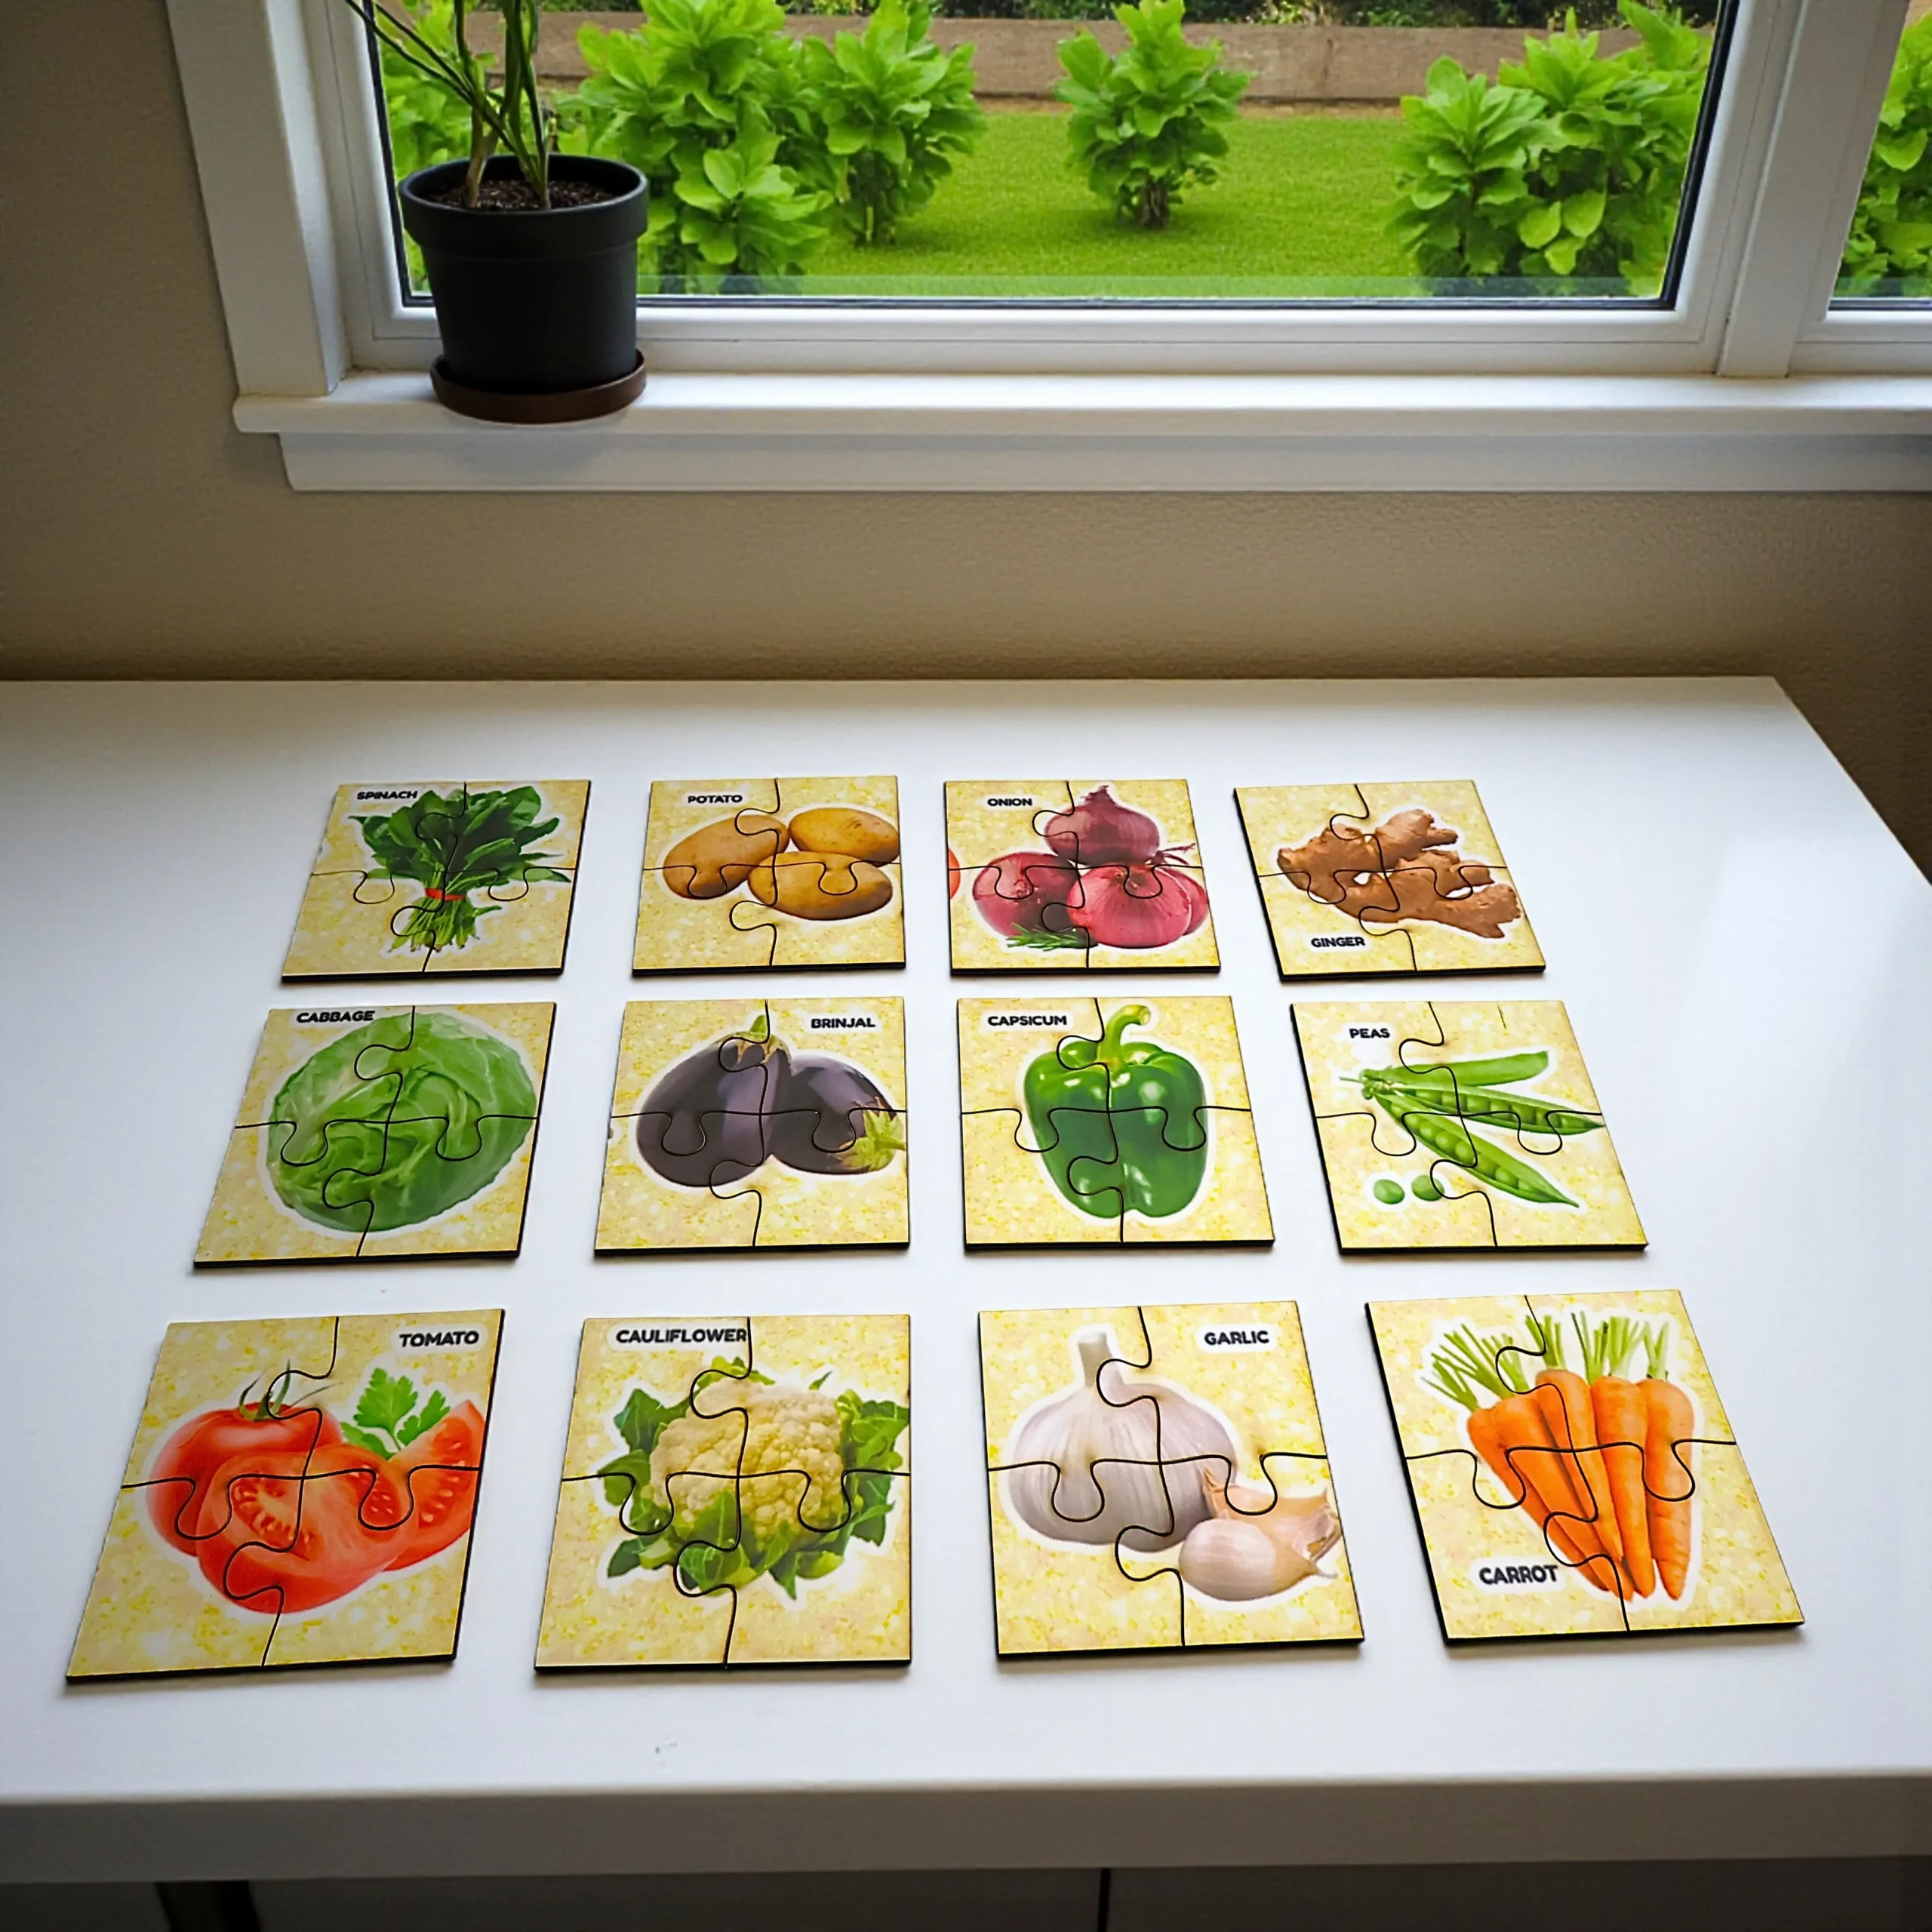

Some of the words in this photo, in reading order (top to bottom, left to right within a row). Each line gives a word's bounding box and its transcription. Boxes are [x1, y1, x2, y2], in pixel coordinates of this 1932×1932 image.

[356, 790, 417, 800] SPINACH
[688, 795, 743, 804] POTATO
[987, 798, 1032, 807] ONION
[1311, 937, 1365, 948] GINGER
[297, 1010, 376, 1023] CABBAGE
[987, 1015, 1067, 1026] CAPSICUM
[811, 1017, 876, 1028] BRINJAL
[1349, 1028, 1391, 1038] PEAS
[399, 1331, 479, 1348] TOMATO
[616, 1329, 747, 1343] CAULIFLOWER
[1204, 1331, 1269, 1346] GARLIC
[1479, 1564, 1558, 1585] CARROT
